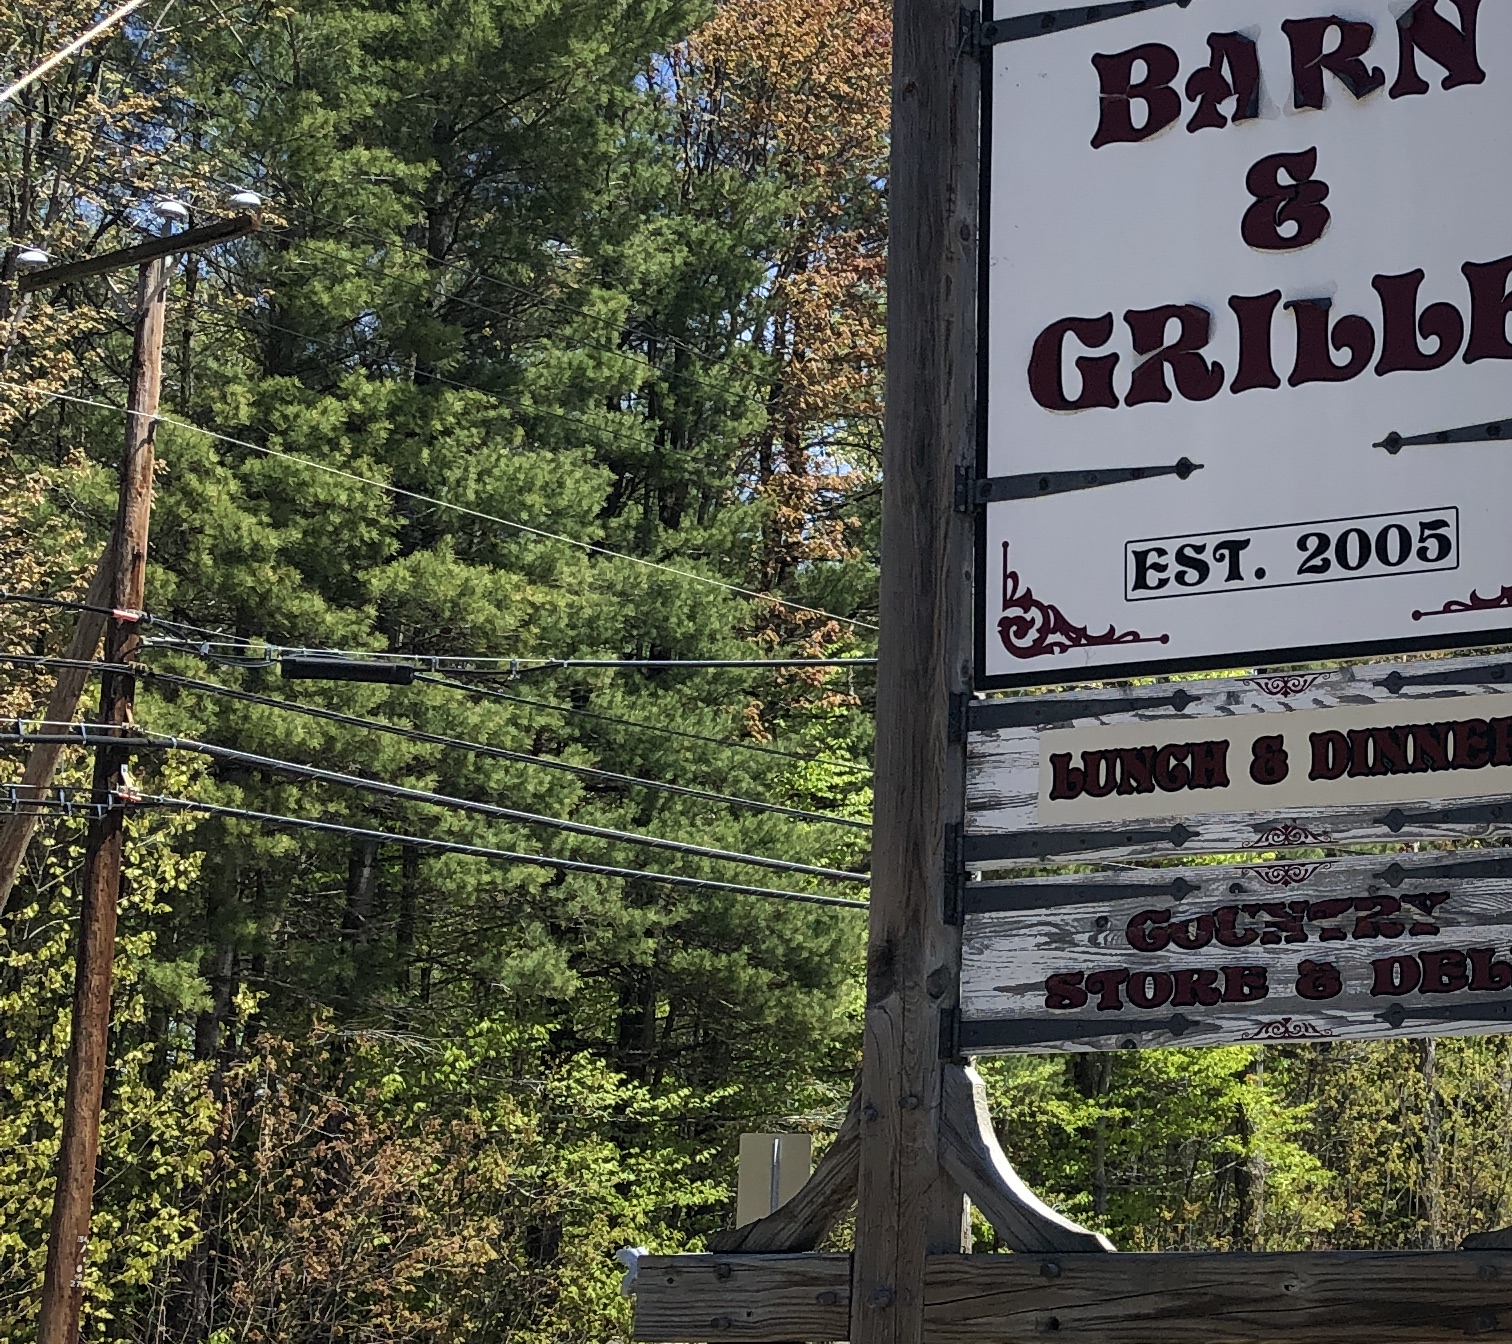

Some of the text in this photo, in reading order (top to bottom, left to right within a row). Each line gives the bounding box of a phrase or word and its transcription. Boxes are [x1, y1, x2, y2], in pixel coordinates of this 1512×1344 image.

[1240, 145, 1331, 252] &
[1130, 518, 1453, 591] EST. 2005
[1048, 738, 1230, 802] LUNCH
[1248, 735, 1290, 787] &
[1126, 891, 1451, 954] COUNTRY
[1044, 964, 1270, 1013] STORE
[1294, 959, 1343, 1001] &
